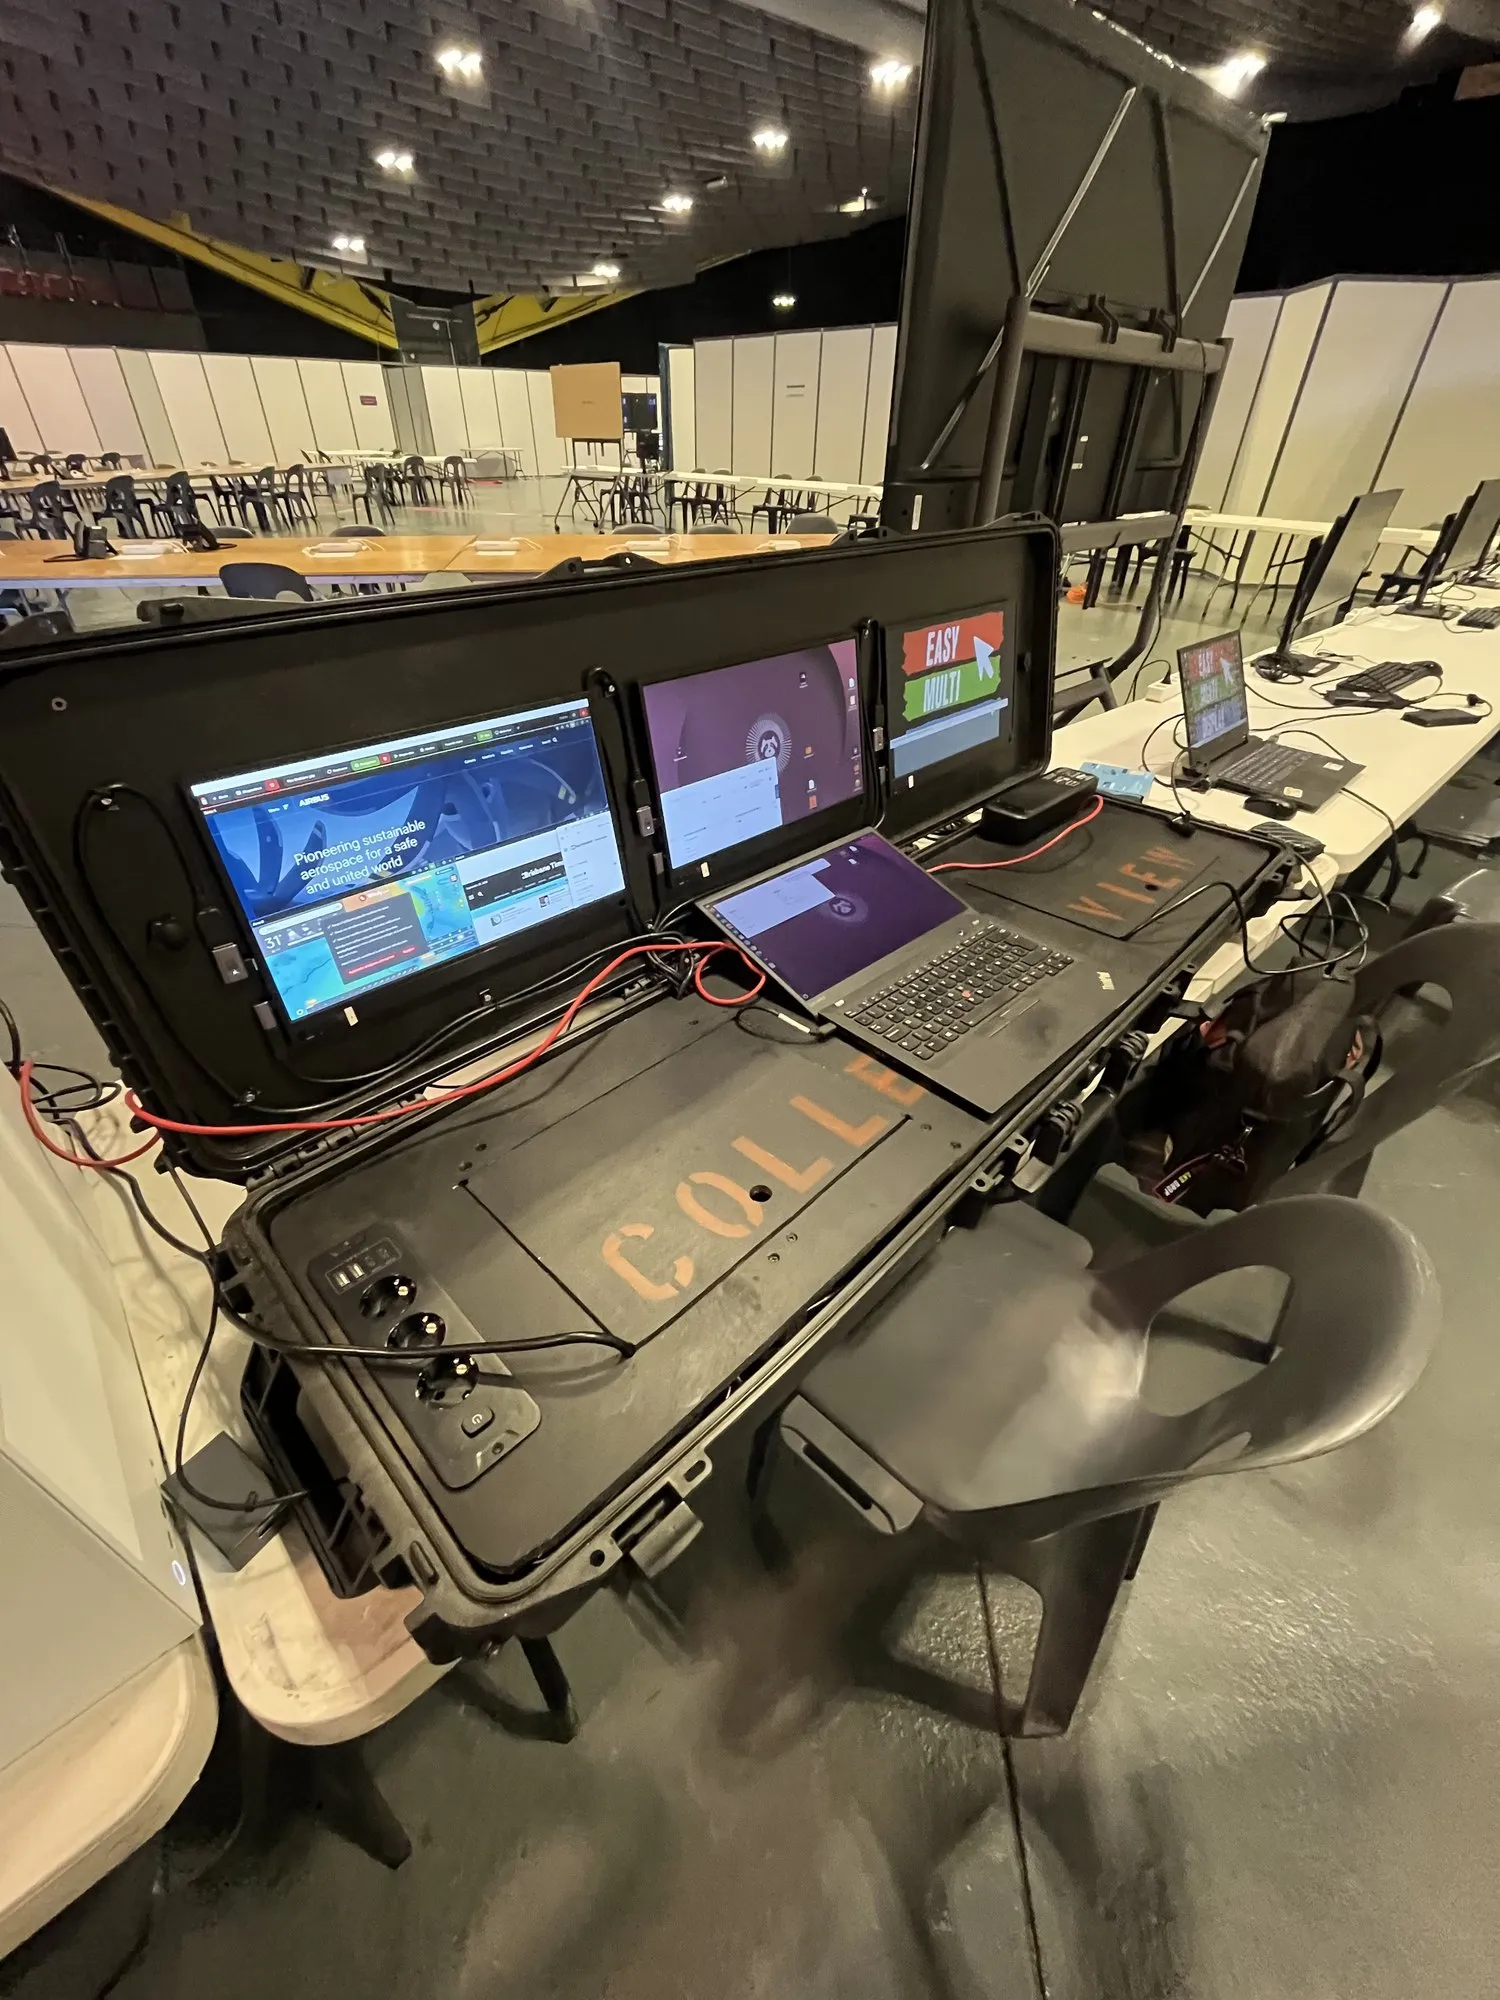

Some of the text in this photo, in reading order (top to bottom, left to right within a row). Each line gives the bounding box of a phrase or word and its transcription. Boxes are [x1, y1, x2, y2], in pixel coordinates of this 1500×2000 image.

[925, 625, 960, 667] EASY
[923, 670, 961, 712] MULTI
[299, 793, 331, 806] AIRBUS
[293, 817, 426, 866] Pioneering sustainable
[299, 835, 418, 881] aerospace for a safe
[304, 854, 403, 894] and united world
[521, 865, 551, 879] Brisbane
[1066, 845, 1197, 921] VIEW
